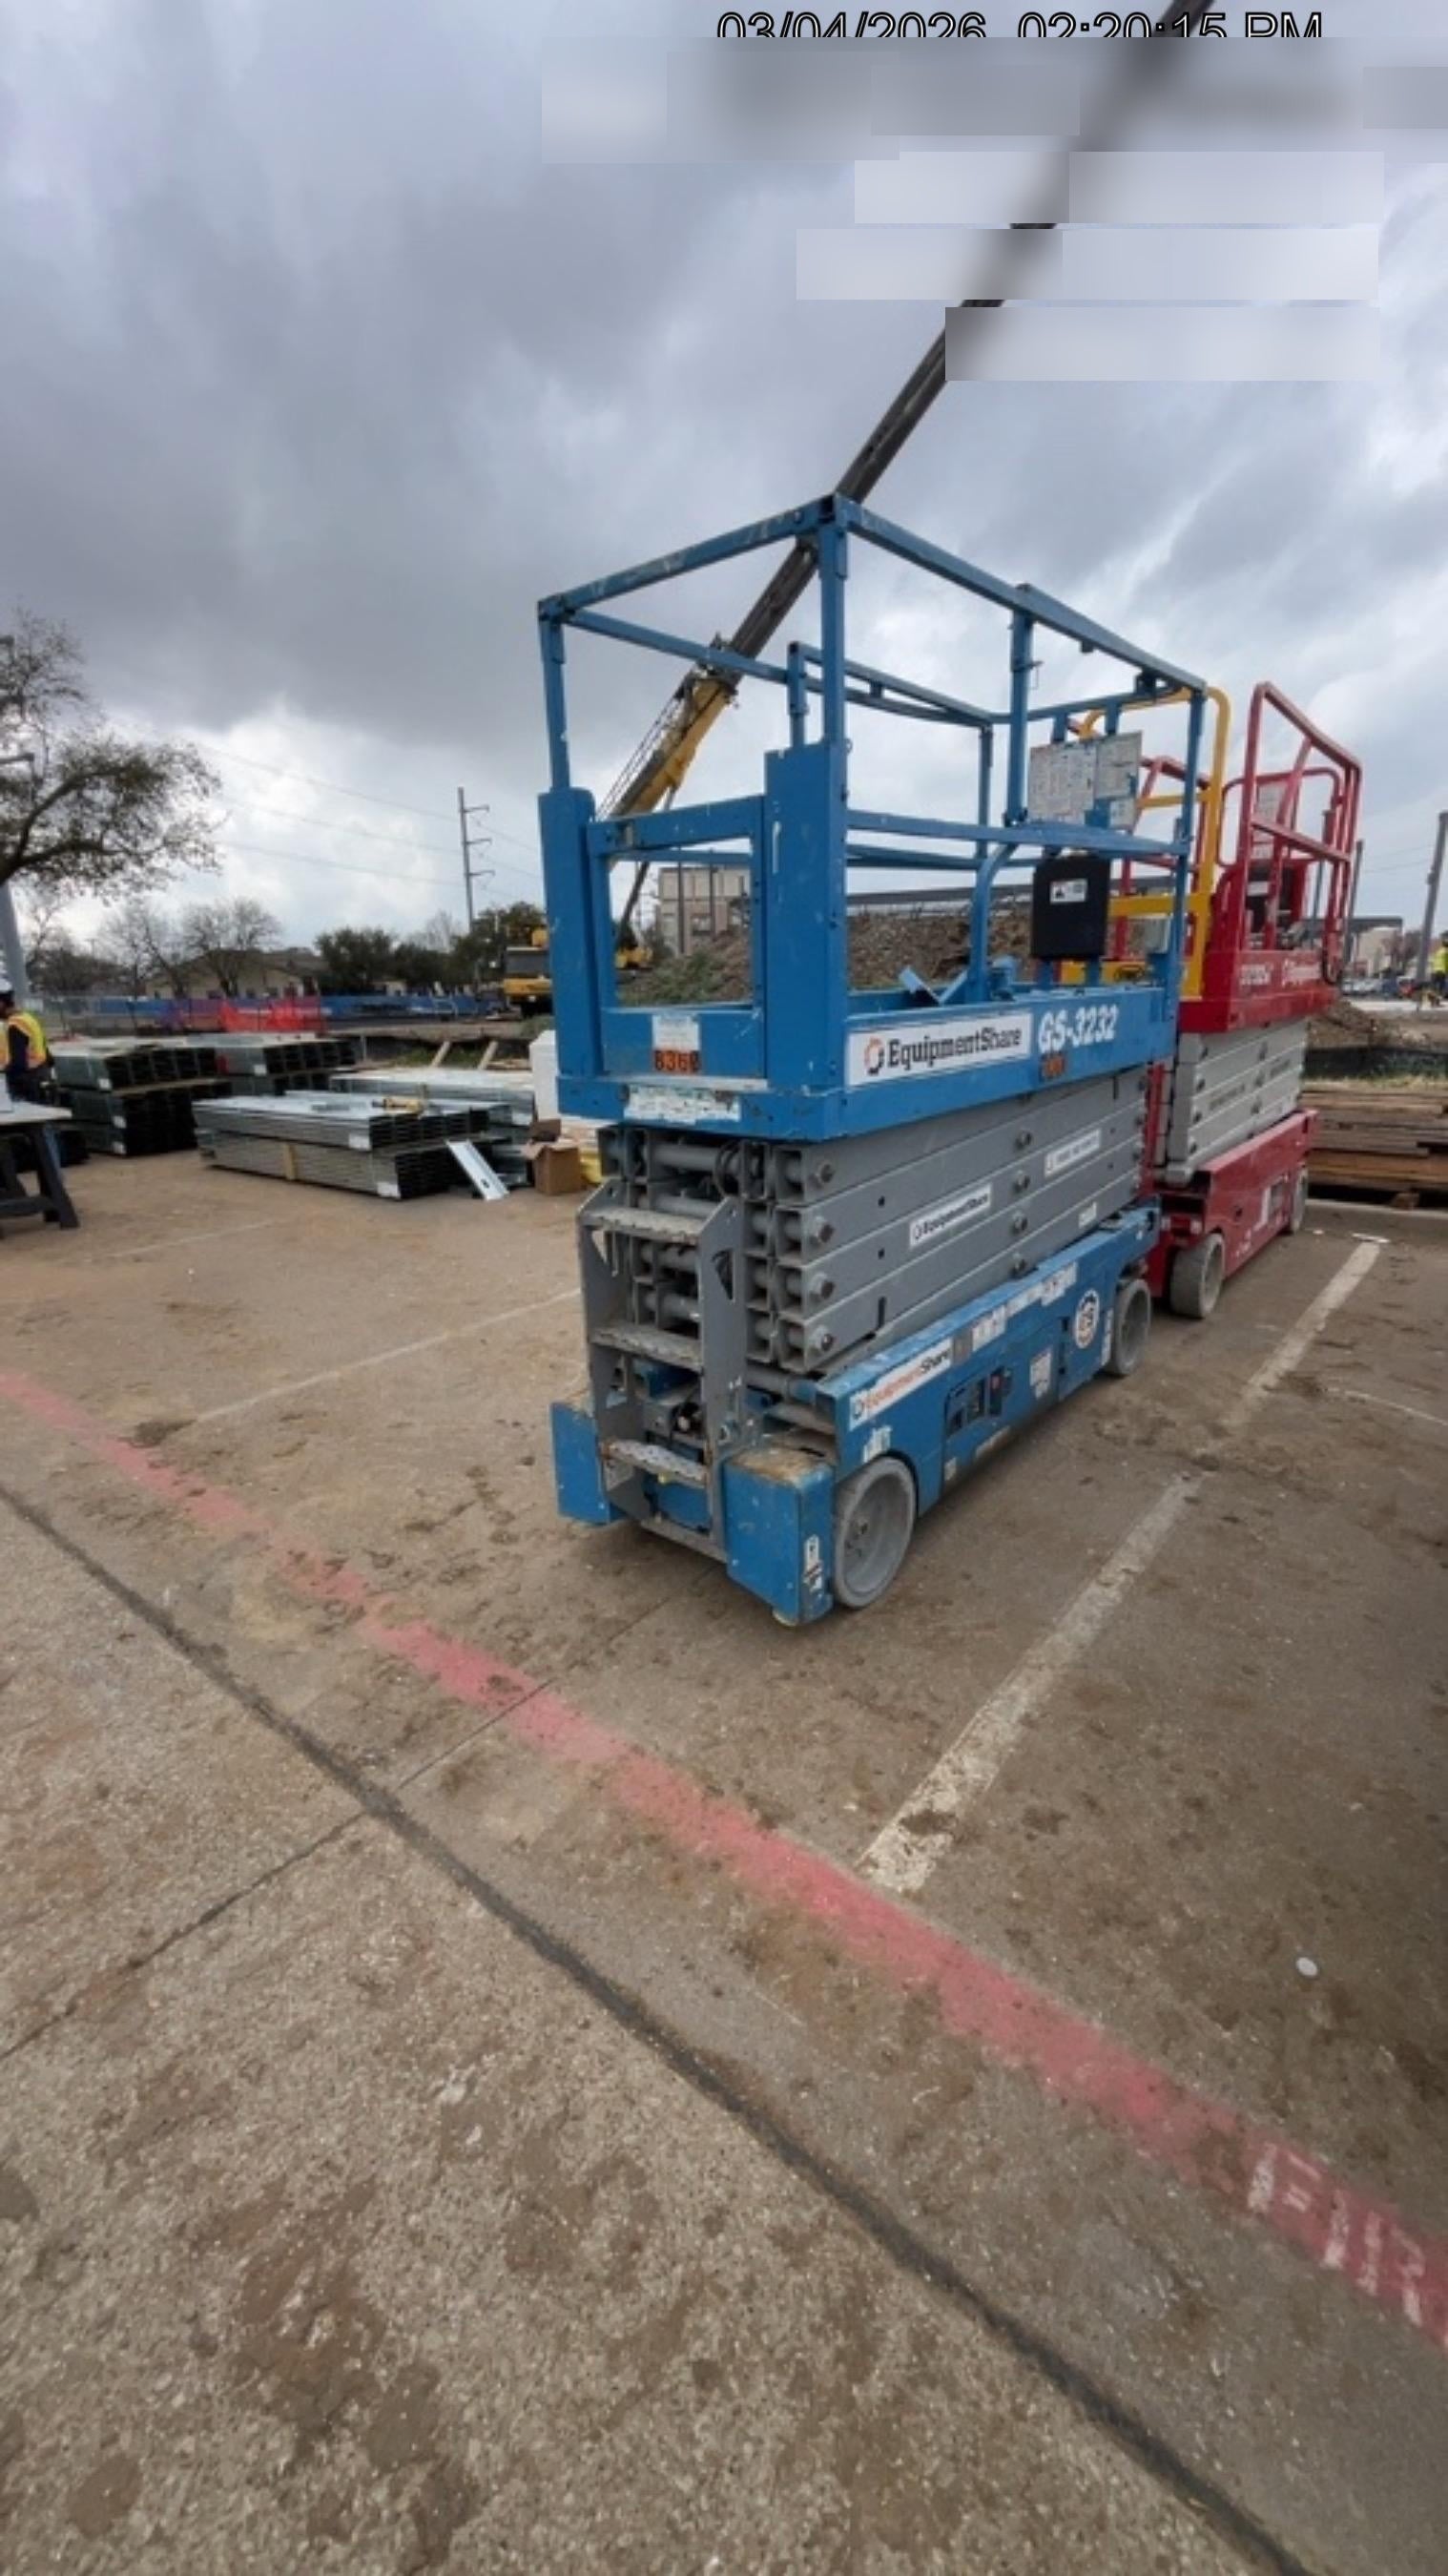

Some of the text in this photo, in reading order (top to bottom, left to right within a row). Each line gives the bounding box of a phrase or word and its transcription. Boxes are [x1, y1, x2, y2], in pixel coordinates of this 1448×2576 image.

[888, 1026, 1022, 1071] EquipmentShare
[1038, 1004, 1119, 1054] GS-3232
[1247, 2143, 1448, 2352] FIR
